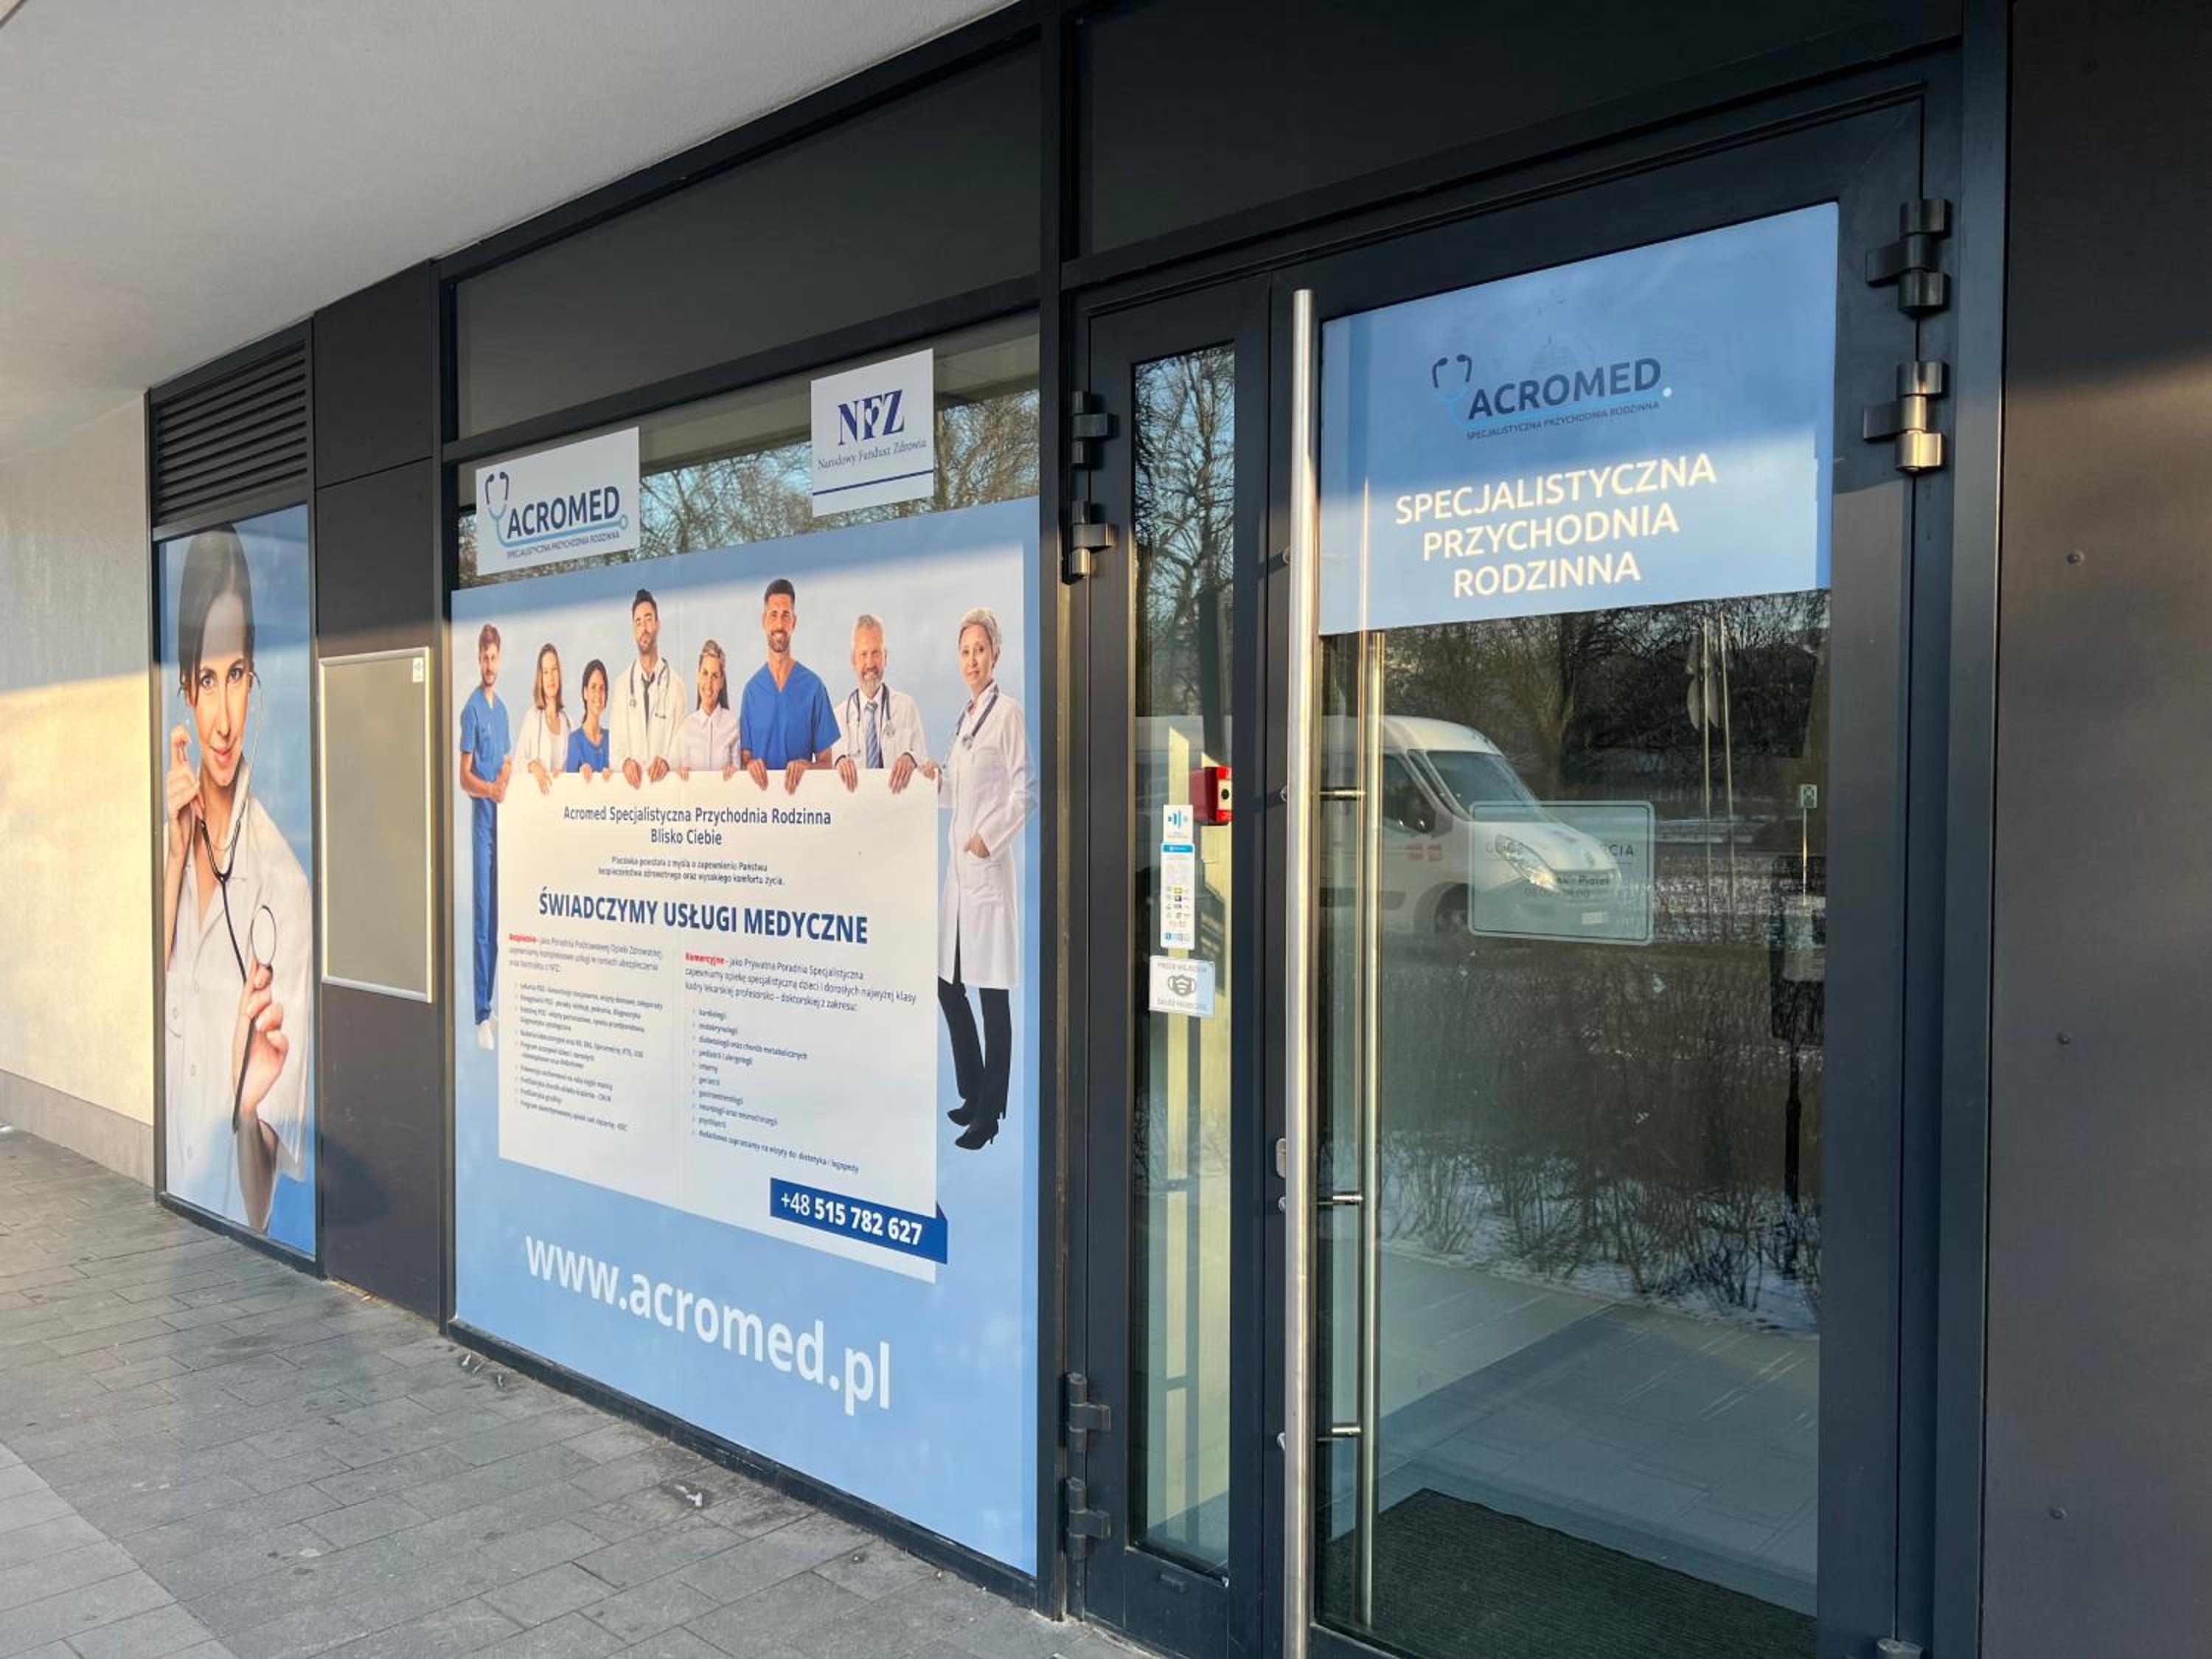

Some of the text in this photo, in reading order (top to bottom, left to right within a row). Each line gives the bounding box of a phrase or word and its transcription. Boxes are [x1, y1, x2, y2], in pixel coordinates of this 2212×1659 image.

[1469, 358, 1660, 420] ACROMED
[838, 389, 905, 445] NFZ
[1467, 401, 1659, 439] SPECJALISTYCZNA PRZYCHODNIA RODZINNA
[818, 439, 926, 470] Narodowy Fundusz Zdrowia
[507, 486, 619, 539] ACROMED
[1396, 452, 1717, 524] SPECJALISTYCZNA
[1424, 502, 1680, 561] PRZYCHODNIA
[1454, 552, 1641, 598] RODZINNA
[564, 806, 832, 826] Acromed Specjalistyczna Przychodnia Rodzinna
[651, 829, 722, 845] Blisko Ciebie
[539, 886, 868, 944] ŚWIADCZYMY USŁUGI MEDYCZNE
[745, 957, 775, 970] Prywatna
[810, 964, 863, 981] Specjalistyczna
[896, 991, 917, 1005] klasy
[781, 1192, 922, 1245] +48 515 782 627
[526, 1235, 890, 1416] www.acromed.pl
